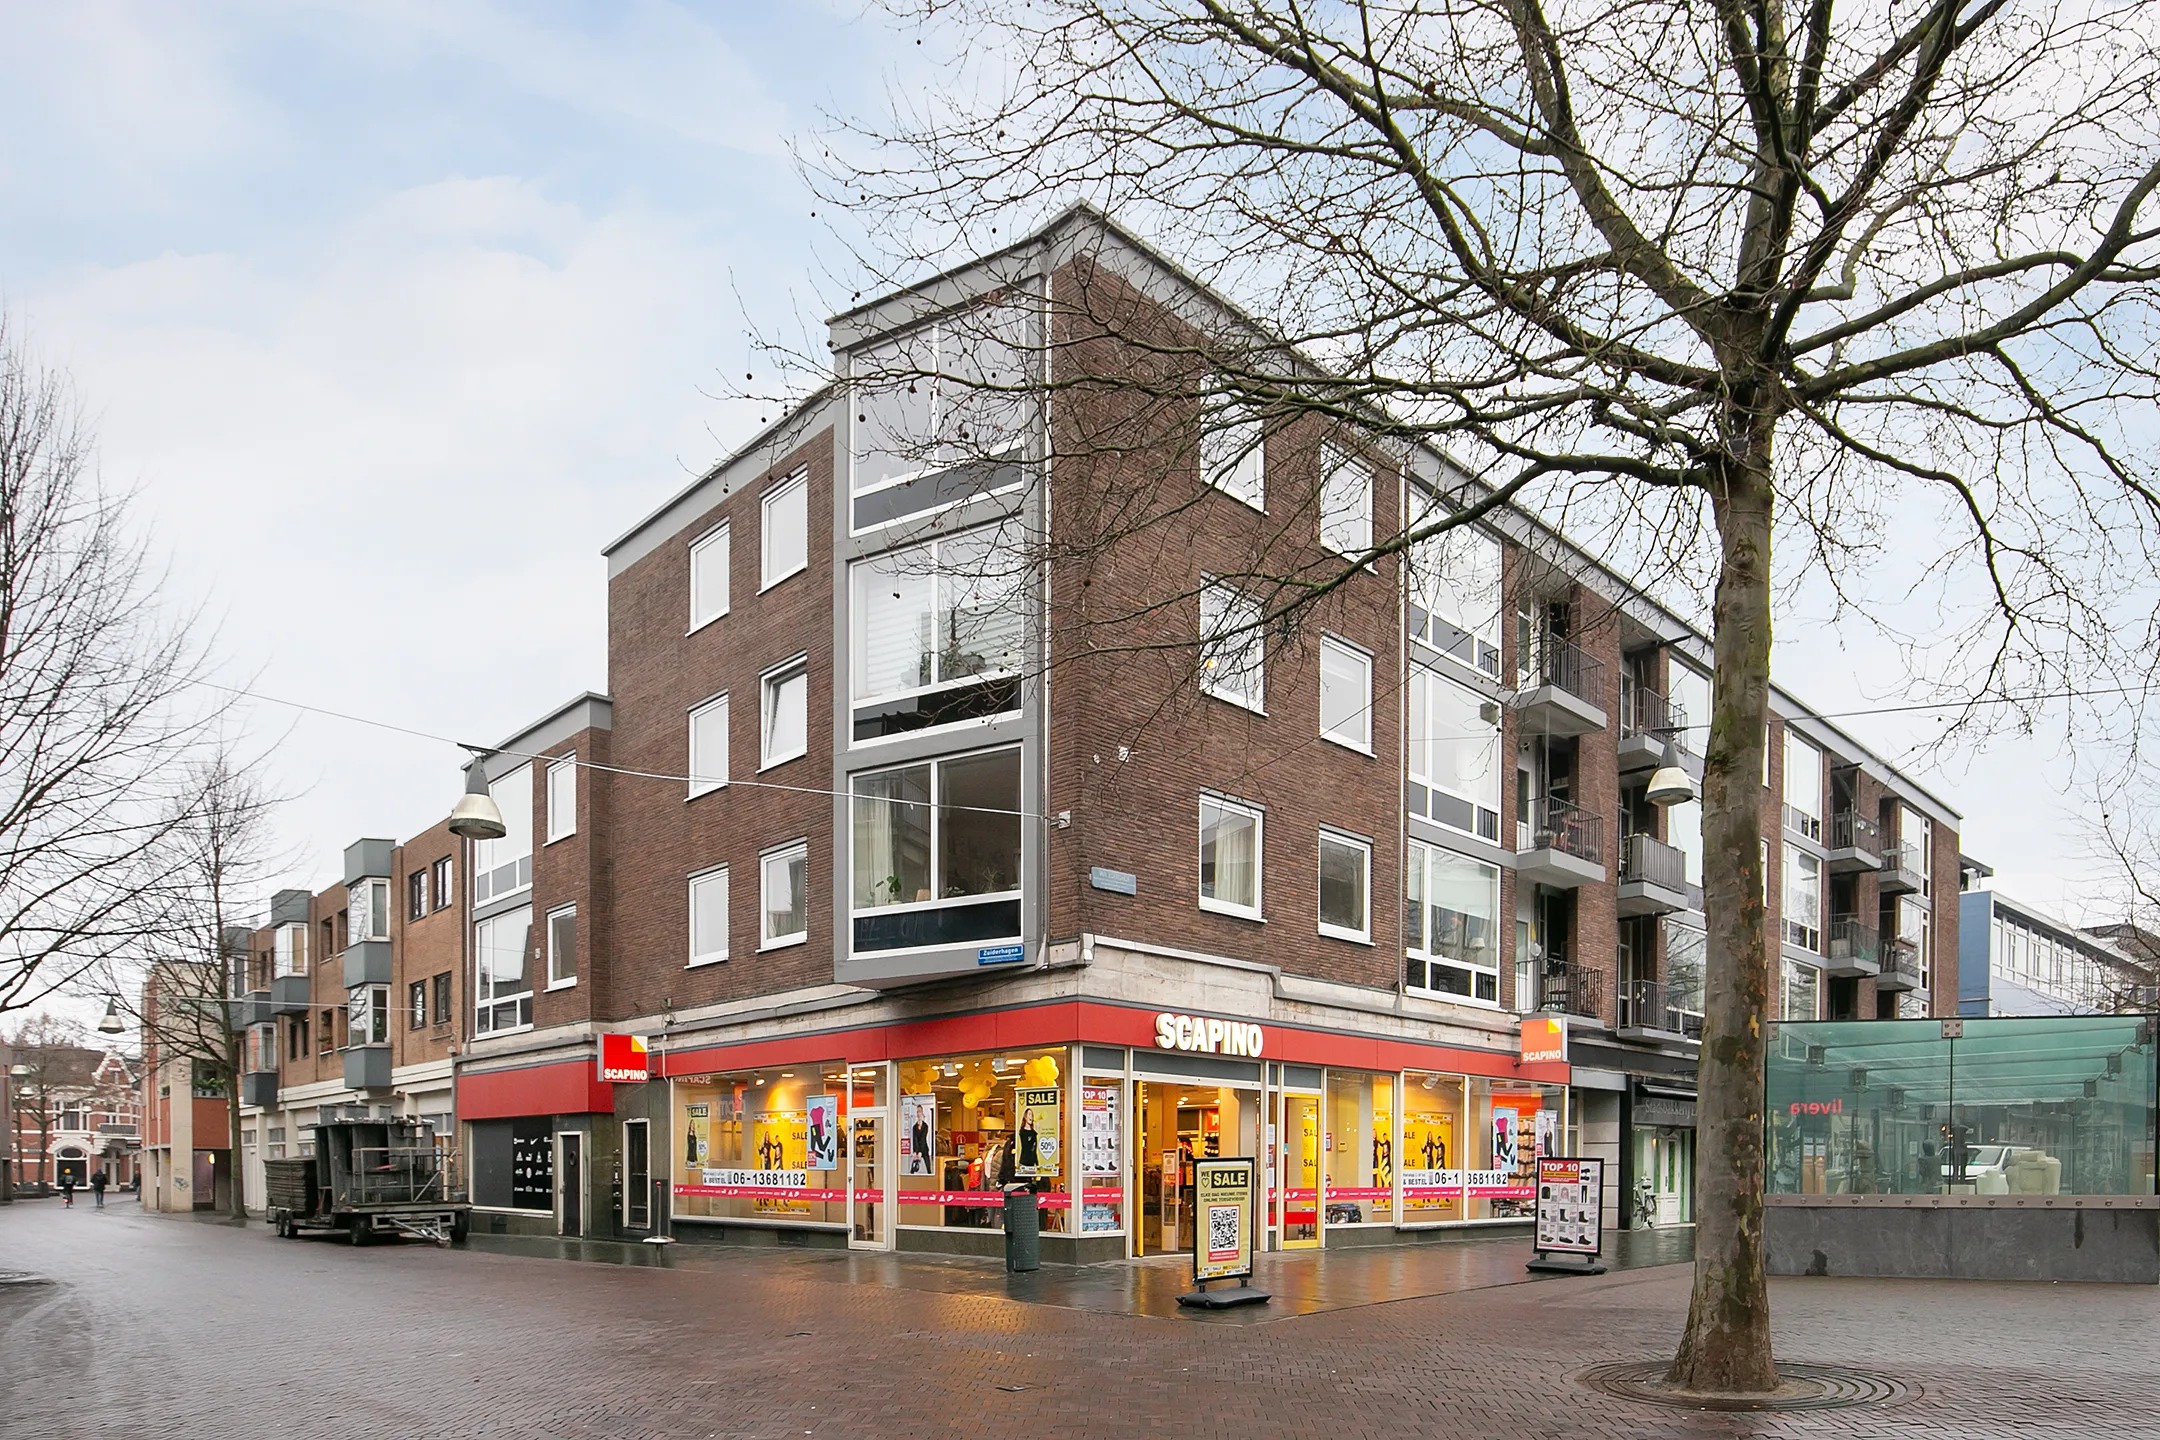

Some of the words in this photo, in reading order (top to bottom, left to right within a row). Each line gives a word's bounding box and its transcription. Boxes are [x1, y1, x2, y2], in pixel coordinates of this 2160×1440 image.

[983, 947, 1019, 956] Zuiderhagen
[1154, 1012, 1264, 1058] SCAPINO
[1523, 1050, 1562, 1062] SCAPINO
[604, 1068, 648, 1081] SCAPINO
[1028, 1092, 1055, 1105] SALE
[1097, 1091, 1106, 1100] 10
[691, 1107, 707, 1117] SALE
[791, 1132, 808, 1140] SALE
[1303, 1128, 1318, 1137] SAL
[1403, 1131, 1416, 1139] ALE
[1040, 1141, 1055, 1151] 50%
[791, 1161, 808, 1170] SALE
[1303, 1158, 1318, 1167] SAL
[1403, 1159, 1416, 1167] ALE
[1542, 1162, 1564, 1172] TOP
[1566, 1163, 1579, 1172] 10
[732, 1172, 807, 1186] 06-13681182
[1213, 1171, 1246, 1187] SALE
[1408, 1178, 1428, 1186] BESTEL
